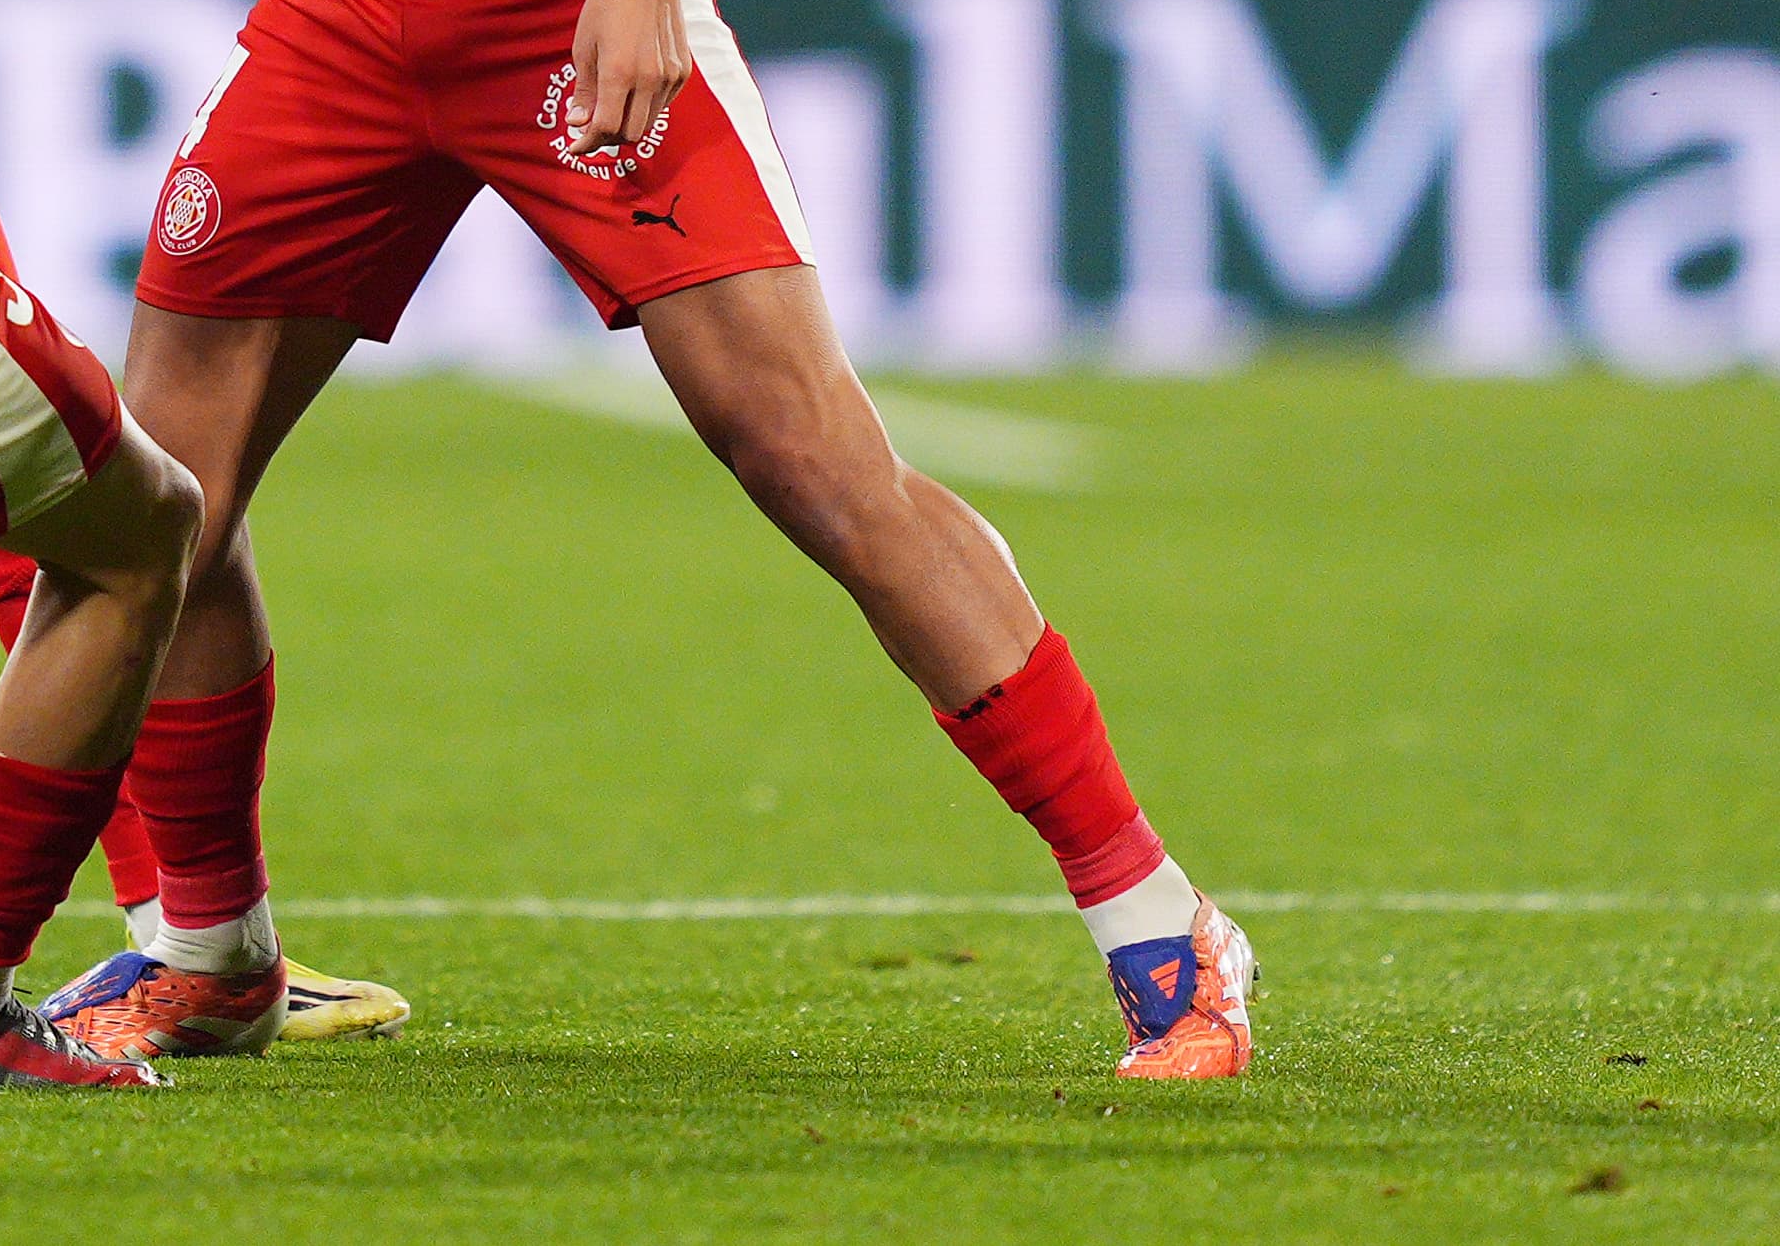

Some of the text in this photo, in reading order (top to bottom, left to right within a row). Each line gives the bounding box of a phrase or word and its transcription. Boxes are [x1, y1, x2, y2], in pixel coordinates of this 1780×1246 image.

[536, 62, 578, 130] Costa
[549, 106, 670, 181] Pirineu de Giron
[174, 170, 214, 200] GIRONA
